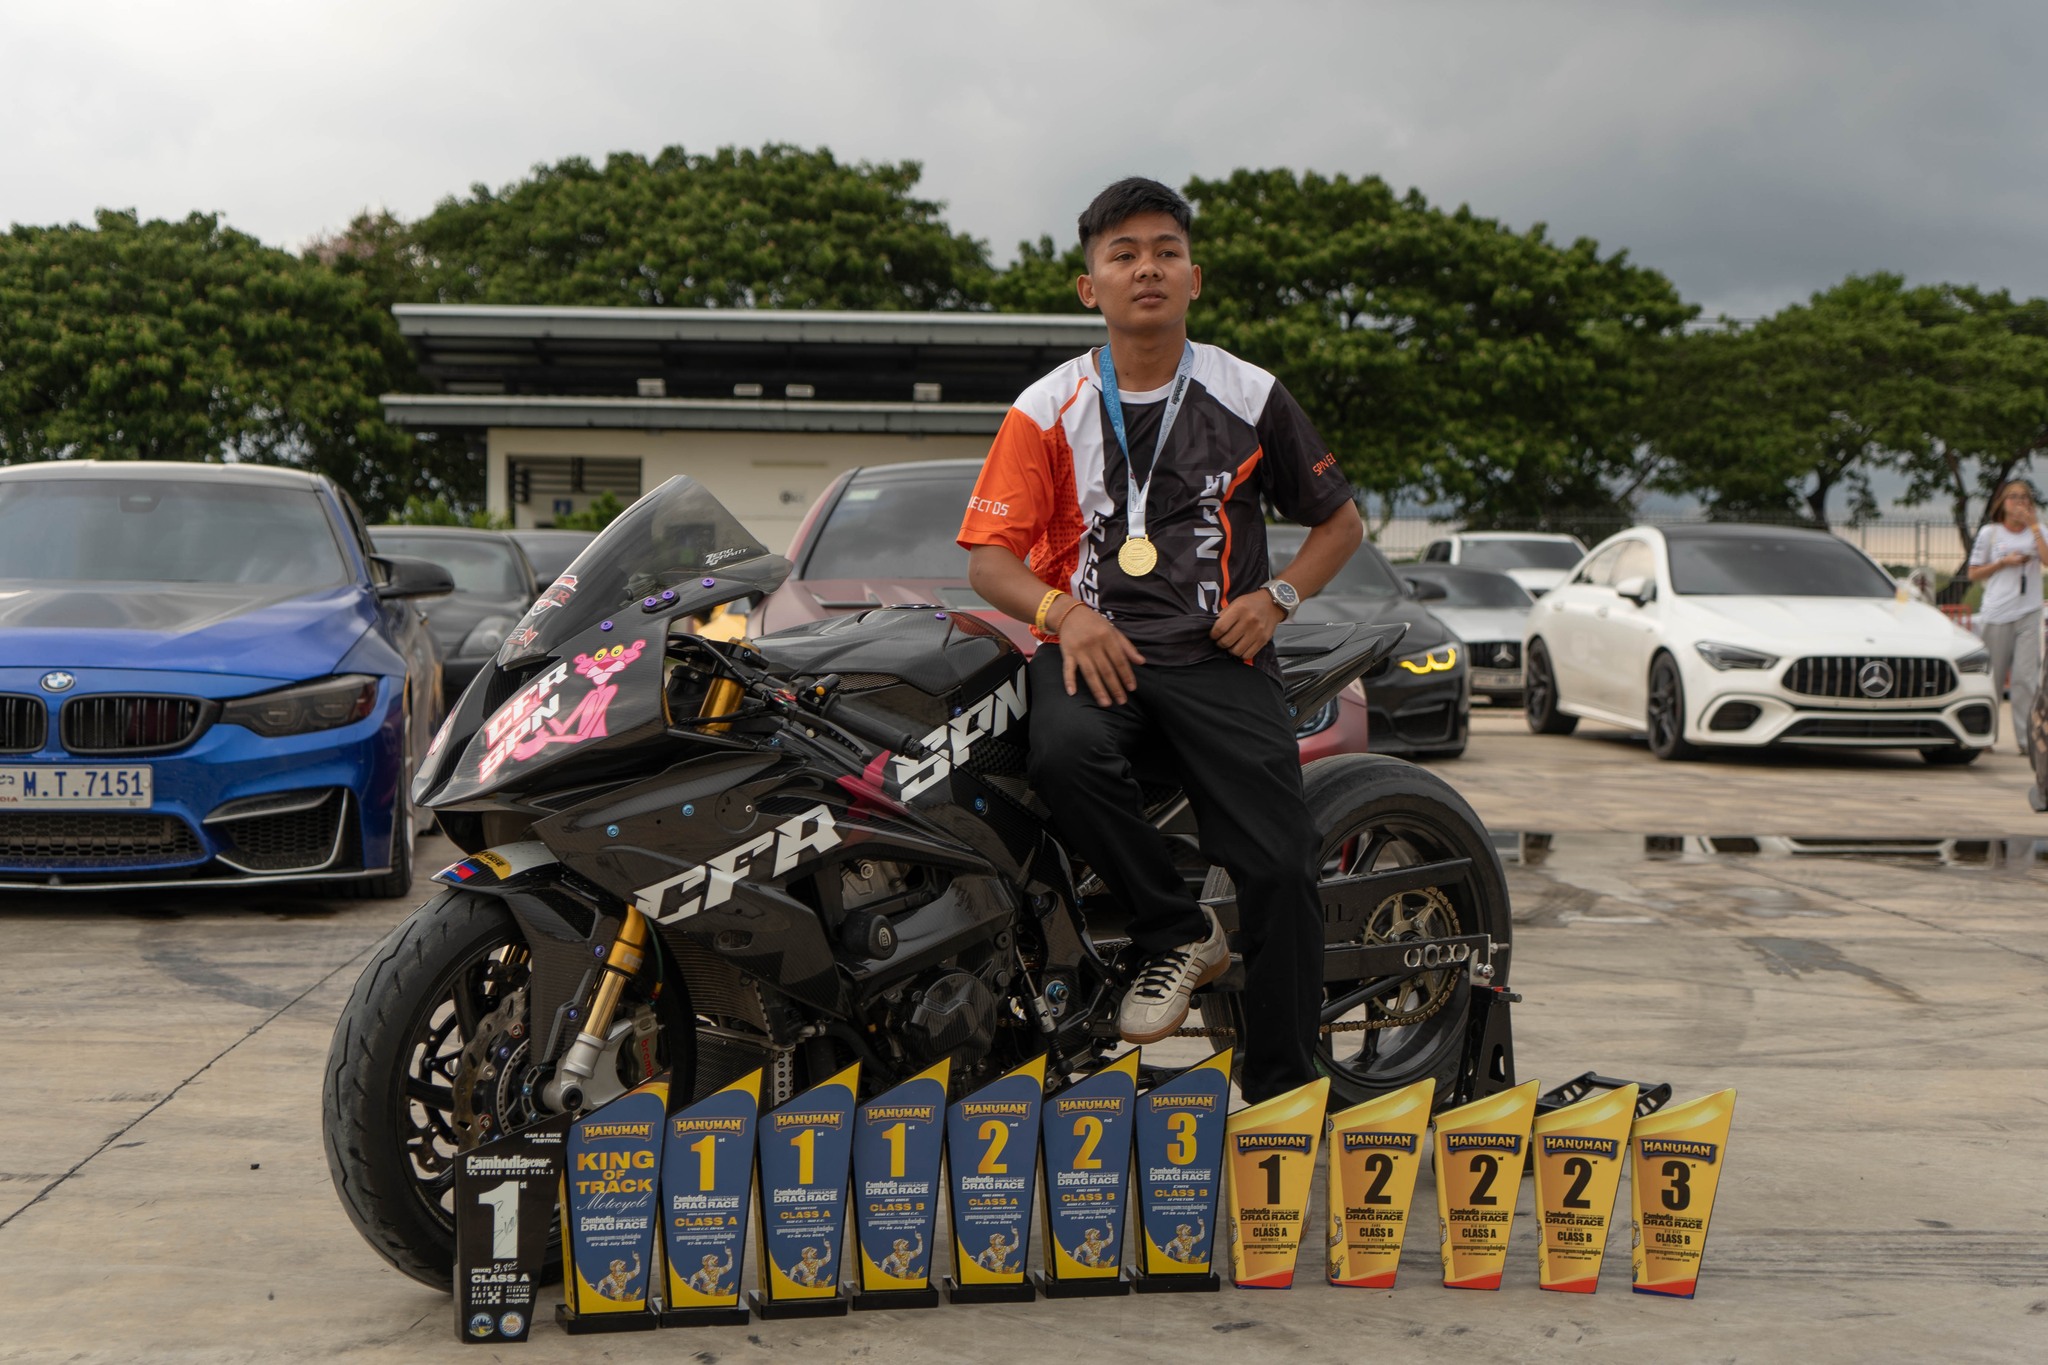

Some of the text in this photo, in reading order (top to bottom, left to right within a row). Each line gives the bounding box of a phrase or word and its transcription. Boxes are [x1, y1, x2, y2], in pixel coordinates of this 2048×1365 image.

[478, 693, 560, 784] SPN
[889, 664, 1028, 802] SPN
[23, 771, 144, 797] M.T.7151
[633, 804, 842, 925] CFR
[1238, 1136, 1306, 1148] HANUMAN
[1345, 1134, 1412, 1146] HANUMAN
[1449, 1136, 1516, 1148] HANUMAN
[1545, 1138, 1613, 1152] HANUMAN
[1643, 1140, 1712, 1156] HANUMAN
[576, 1150, 655, 1171] KING
[602, 1169, 626, 1180] OF
[576, 1178, 653, 1195] TRACK
[1061, 1192, 1116, 1202] CLASS B
[1154, 1189, 1208, 1197] CLASS B
[869, 1202, 925, 1212] CLASS B
[968, 1198, 1007, 1206] CLASS
[780, 1210, 831, 1219] CLASS A
[675, 1216, 737, 1227] CLASS A
[1253, 1227, 1287, 1238] CLASS A
[1359, 1227, 1394, 1238] CLASS B
[1462, 1228, 1497, 1239] CLASS A
[1557, 1231, 1592, 1243] CLASS B
[1655, 1232, 1690, 1245] CLASS B
[471, 1273, 530, 1283] CLASS A
